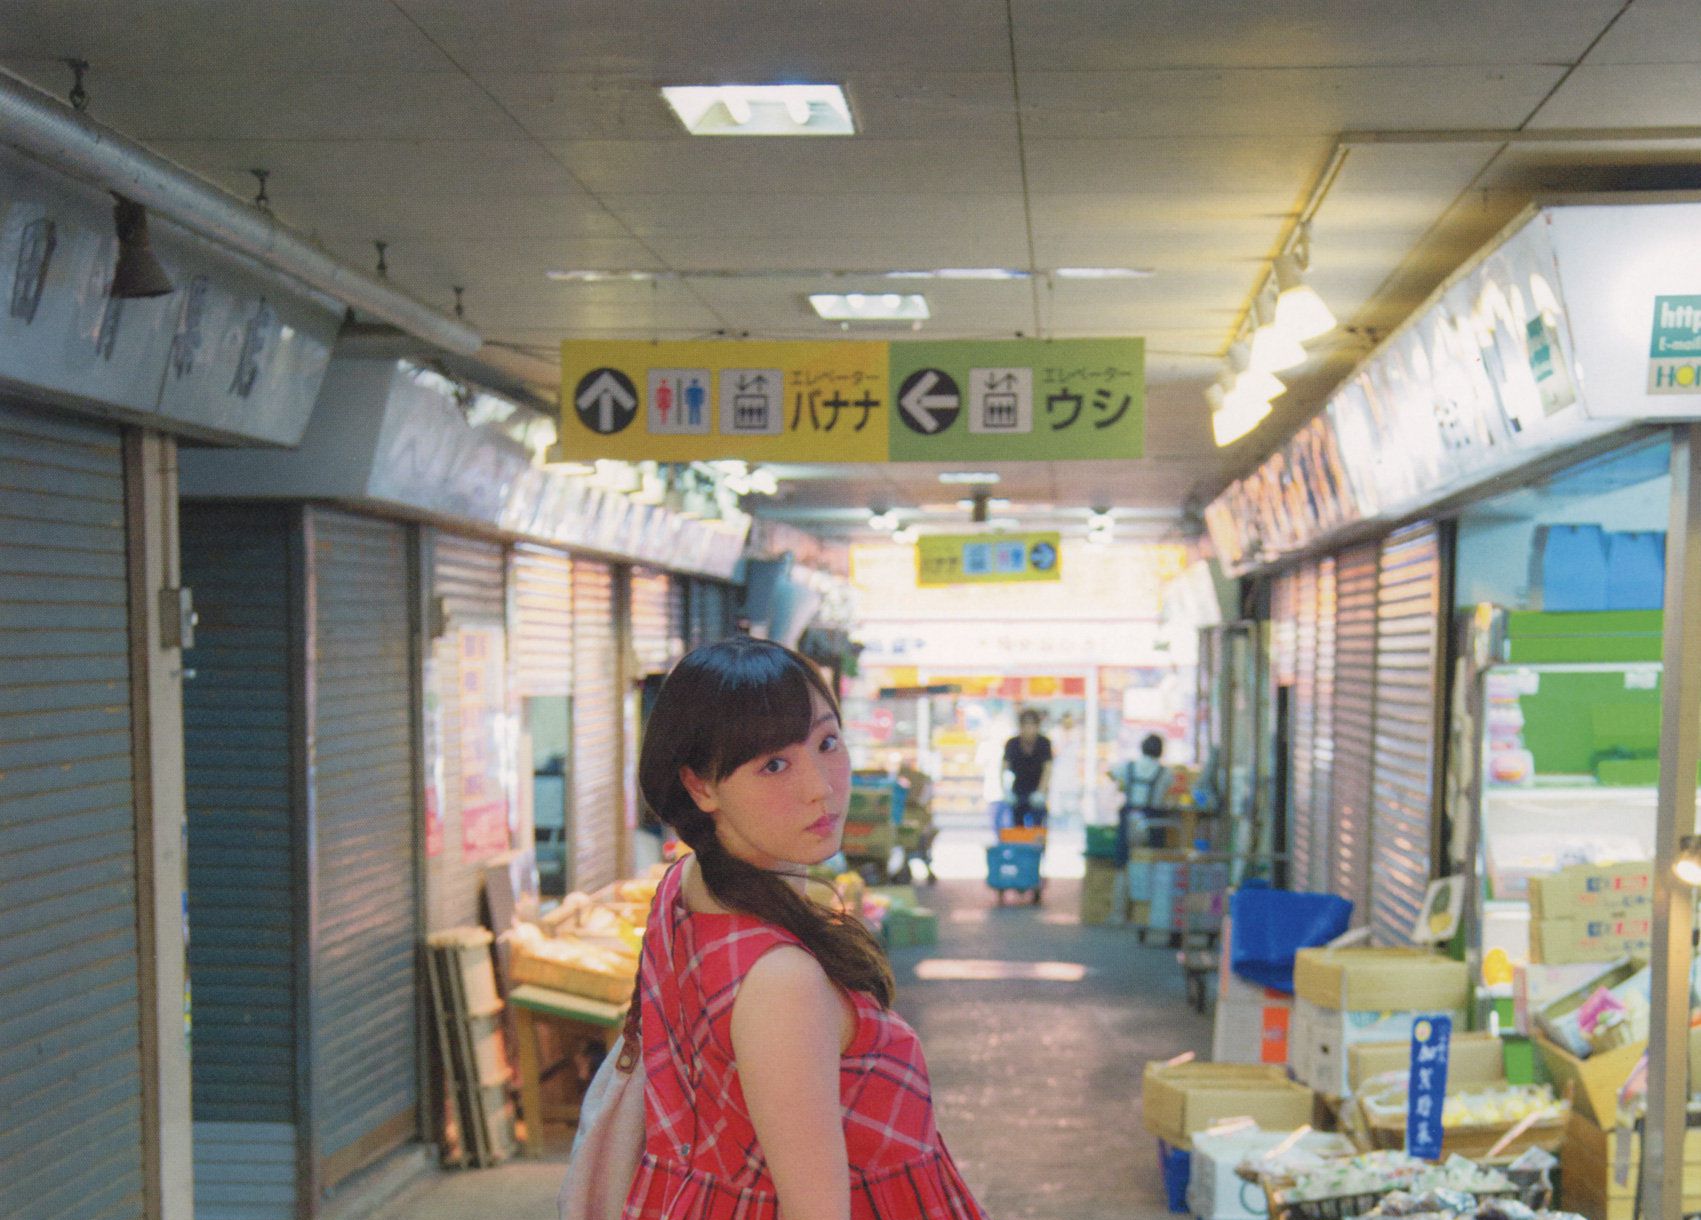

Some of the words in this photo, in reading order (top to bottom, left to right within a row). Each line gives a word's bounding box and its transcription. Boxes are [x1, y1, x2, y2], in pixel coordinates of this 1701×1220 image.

[790, 370, 880, 385] エレベーター
[1041, 367, 1132, 383] エレベーター
[790, 389, 881, 431] バナナ
[1046, 387, 1132, 430] ウシ
